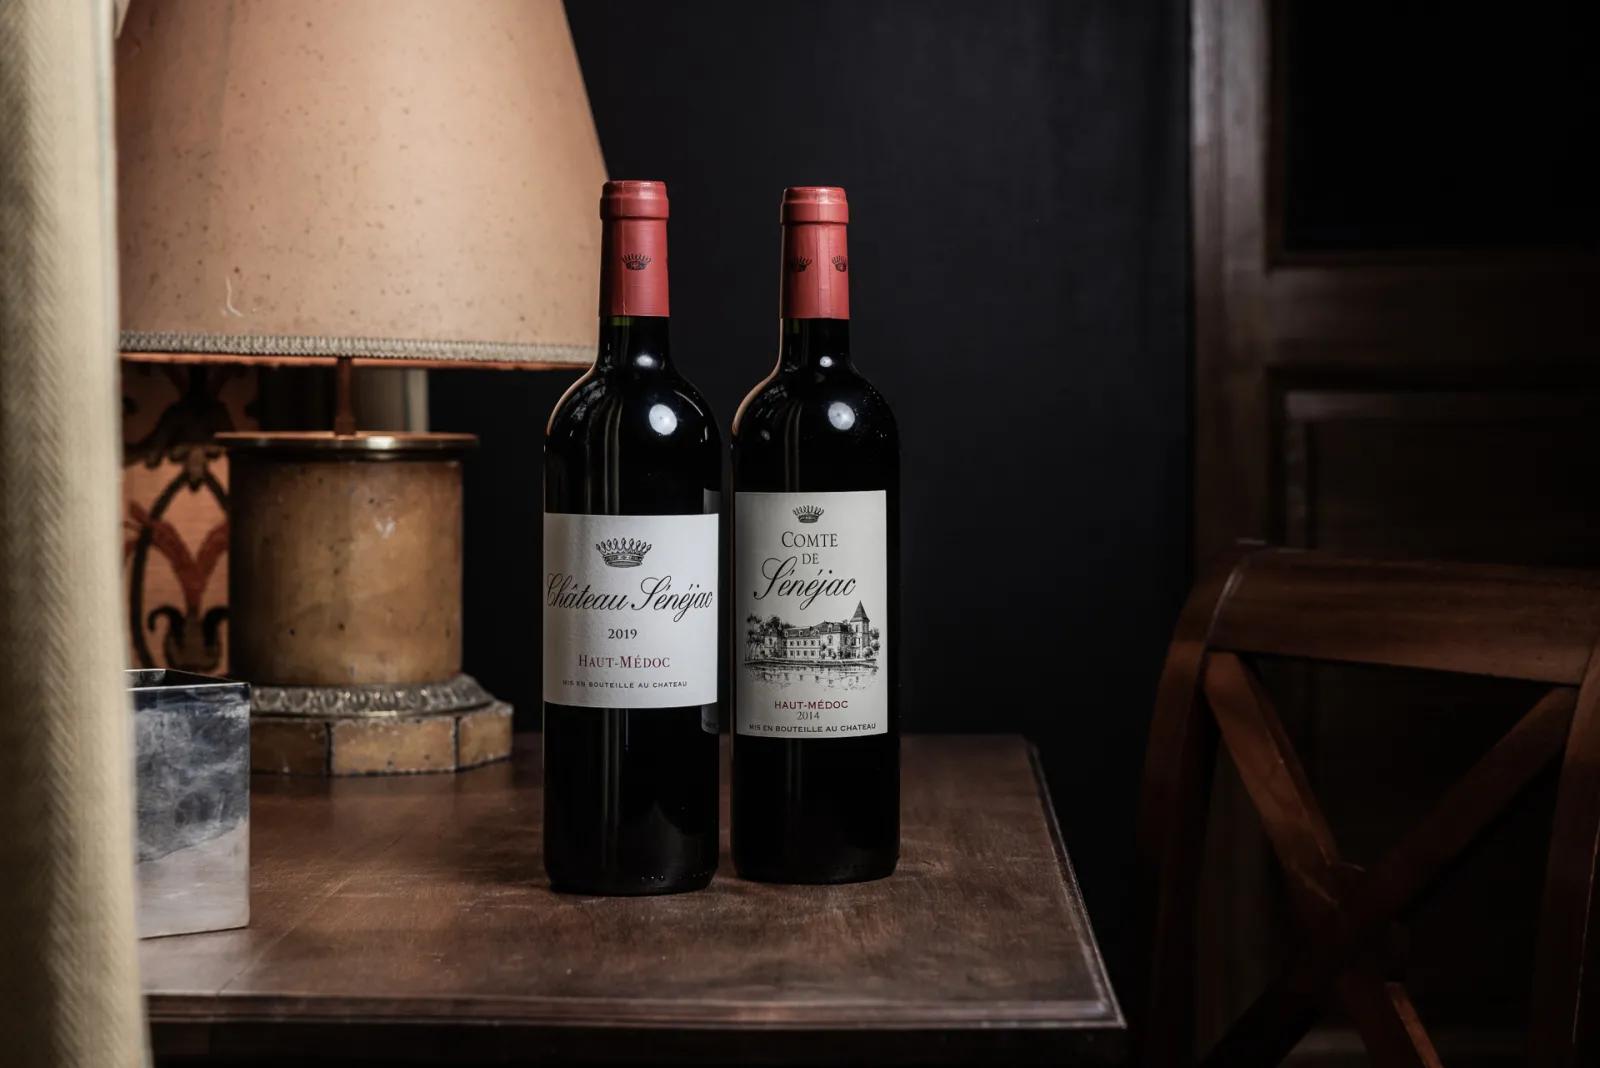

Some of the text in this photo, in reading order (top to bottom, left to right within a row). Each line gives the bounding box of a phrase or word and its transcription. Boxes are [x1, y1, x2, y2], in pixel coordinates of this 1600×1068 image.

[781, 531, 839, 549] COMTE
[801, 553, 820, 565] DE
[753, 556, 857, 611] Sénéjac
[547, 573, 713, 623] Château Sénéjac
[608, 628, 638, 640] 2019
[562, 679, 688, 689] MIS EN BOUTEILLE AU CHATEAU
[774, 699, 849, 710] HAUT-MÉDOC
[796, 711, 820, 721] 2014
[749, 722, 877, 733] MIS EN BOUTEILLE AU CHATEAU
